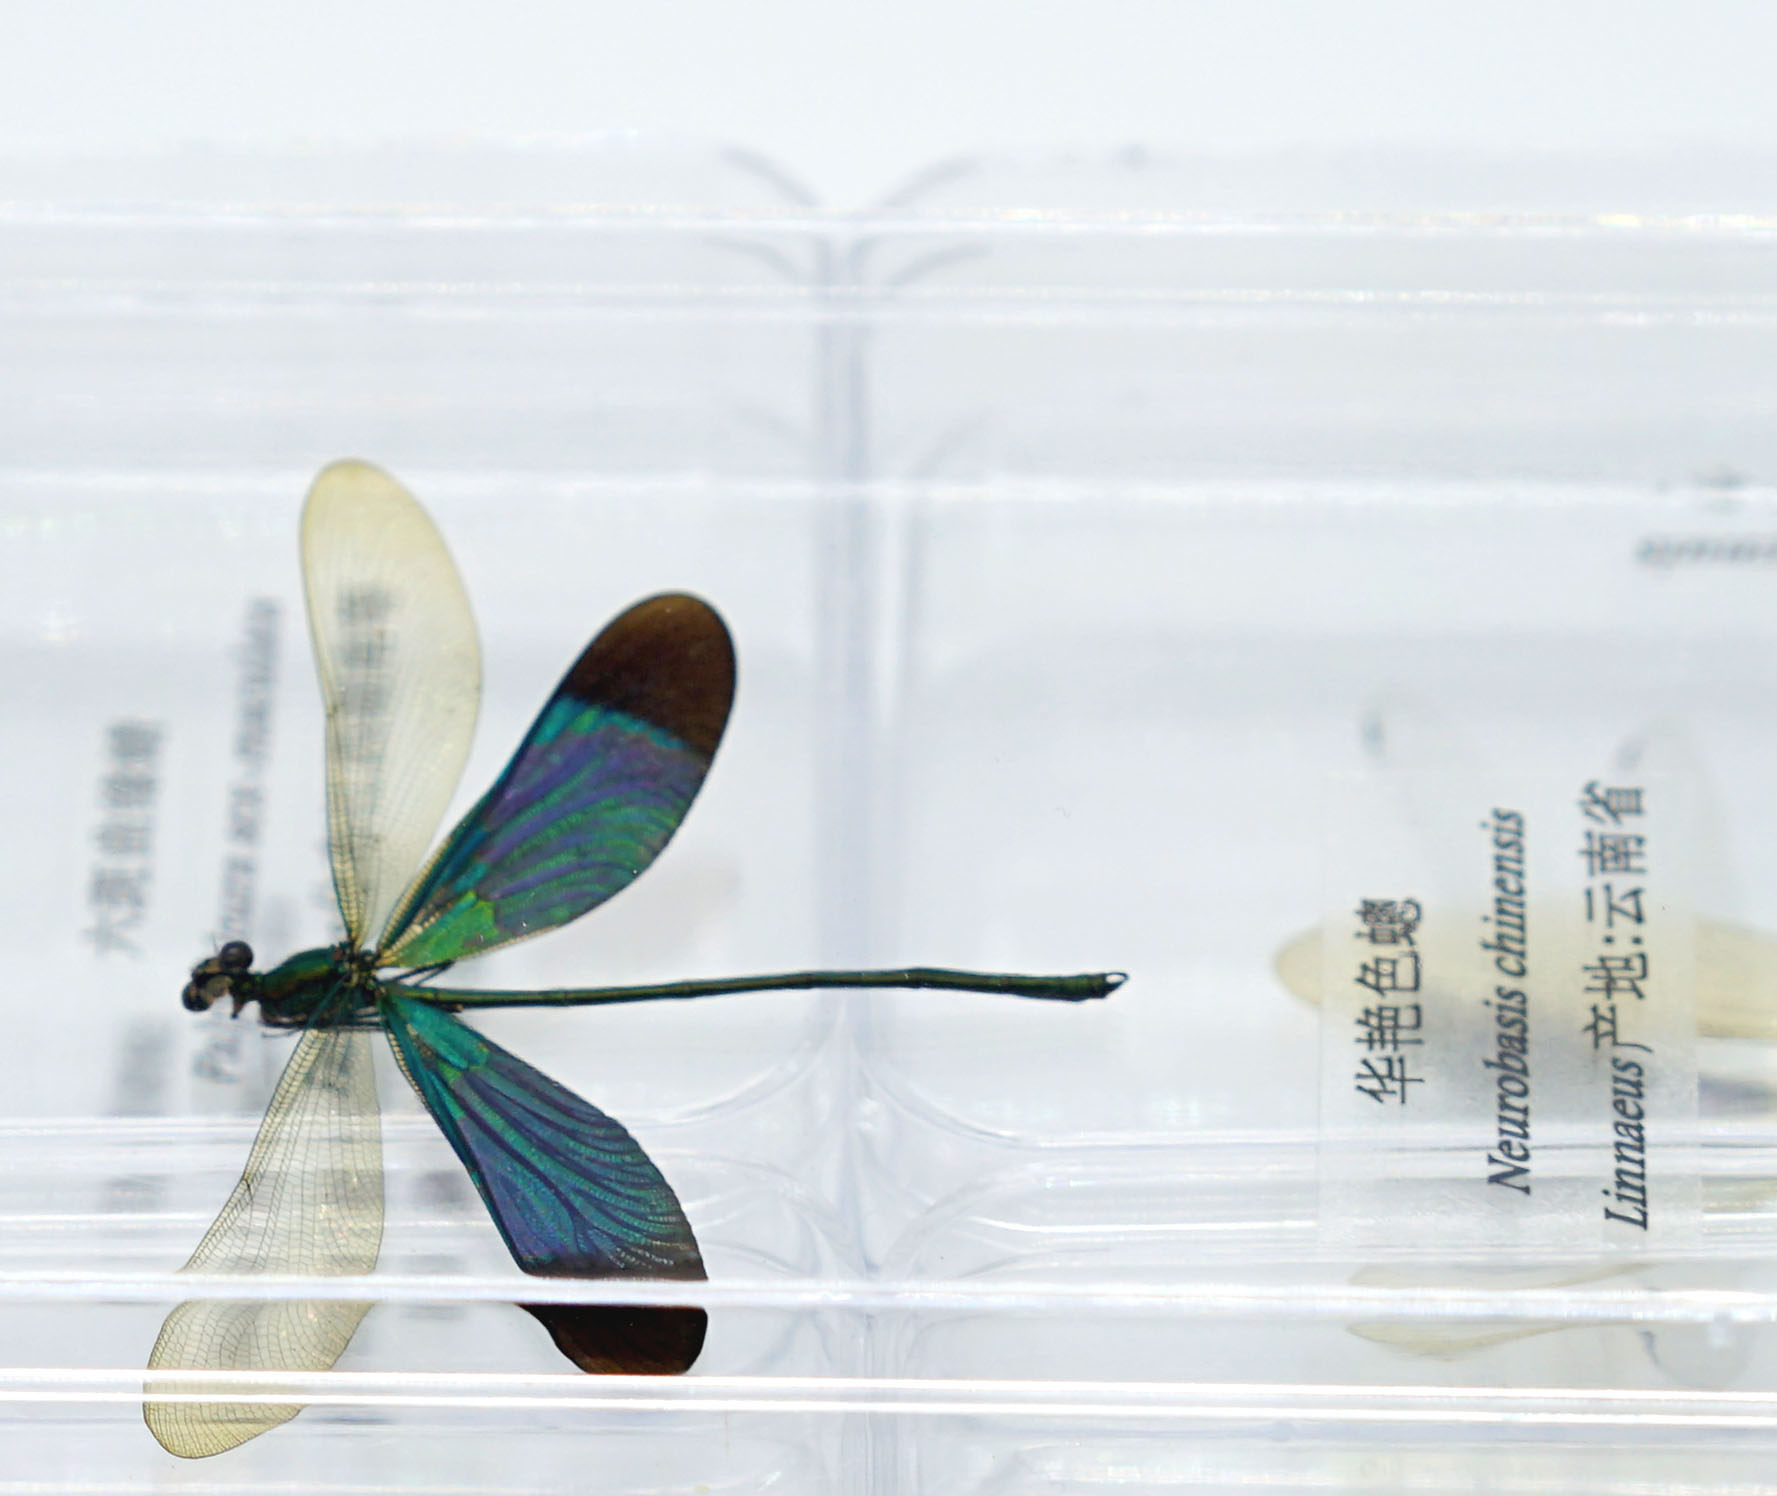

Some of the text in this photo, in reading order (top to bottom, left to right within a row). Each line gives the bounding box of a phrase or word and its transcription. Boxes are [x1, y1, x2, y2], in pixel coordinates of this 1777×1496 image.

[1479, 808, 1531, 1195] Neurobasis chinensis
[1602, 1057, 1649, 1230] Linnaeus
